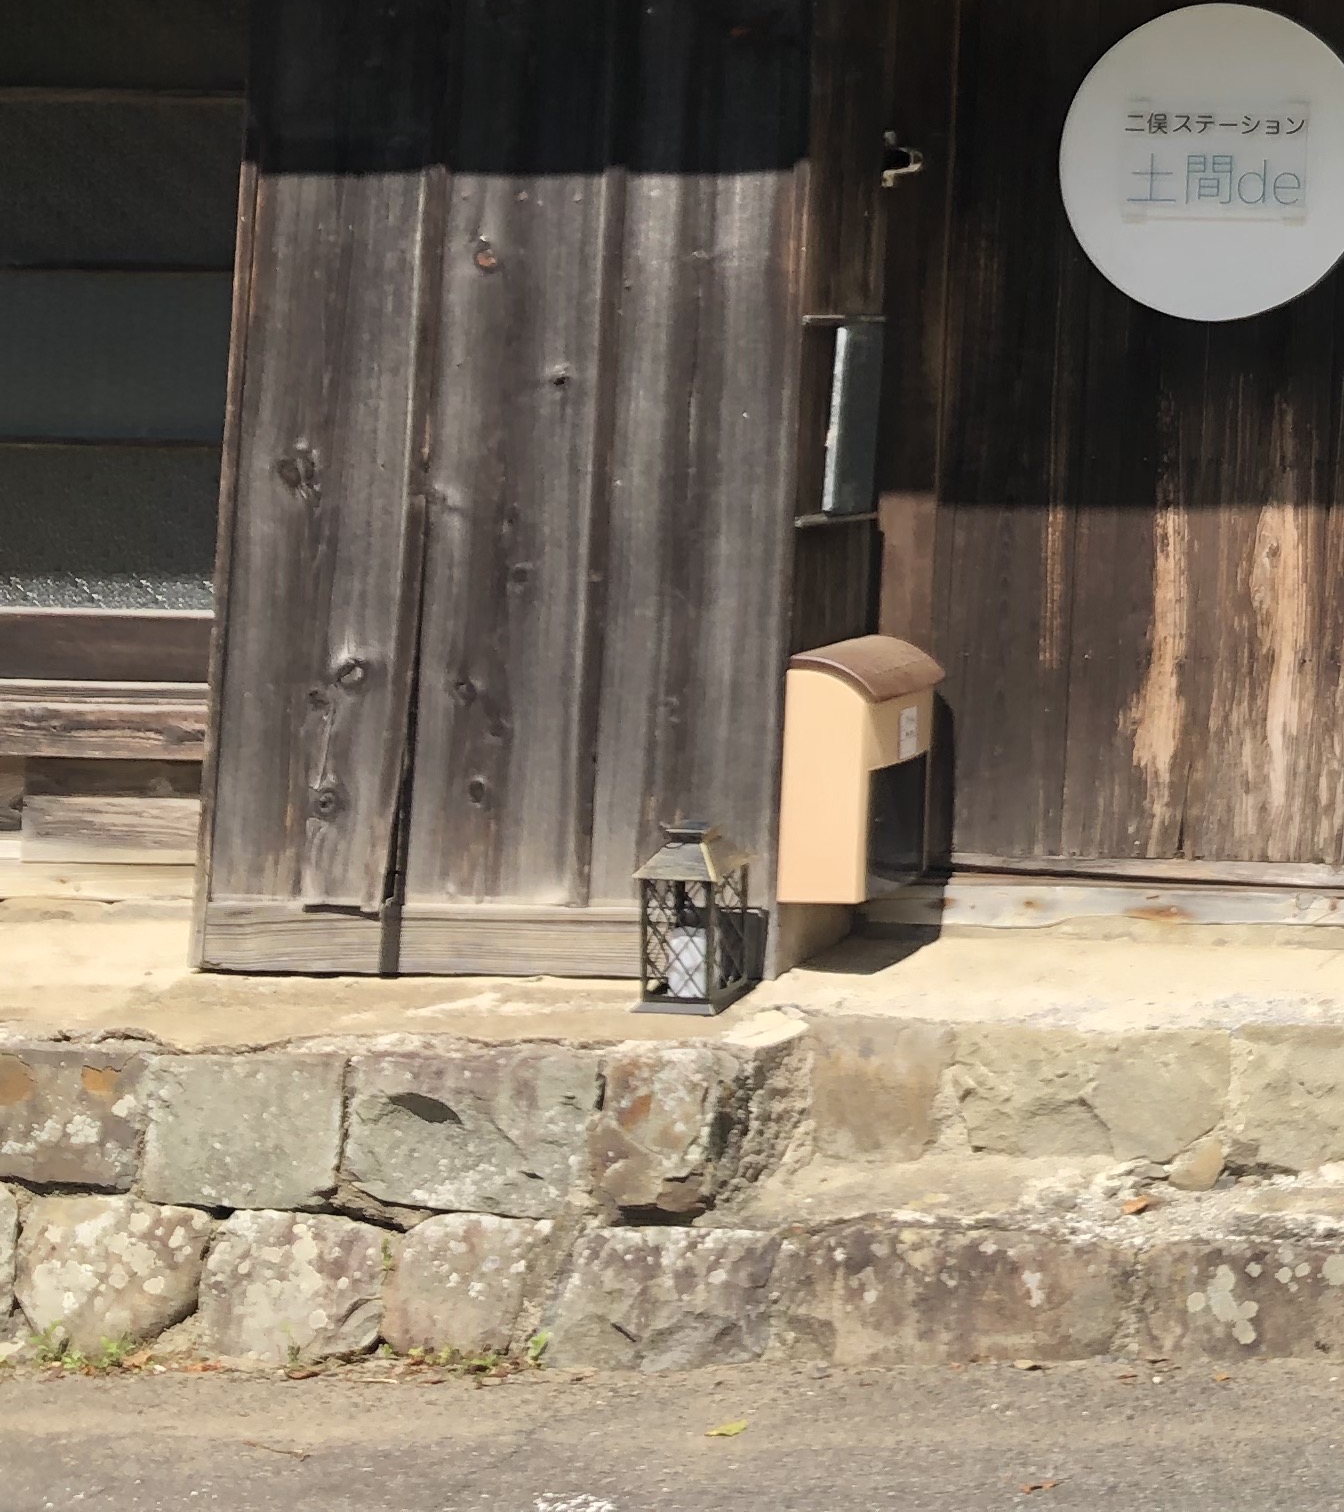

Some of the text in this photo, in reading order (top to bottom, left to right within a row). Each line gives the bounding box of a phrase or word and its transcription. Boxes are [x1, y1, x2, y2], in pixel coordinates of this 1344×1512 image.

[1125, 112, 1306, 136] 二俣ステーション
[1126, 152, 1302, 205] 土間de
